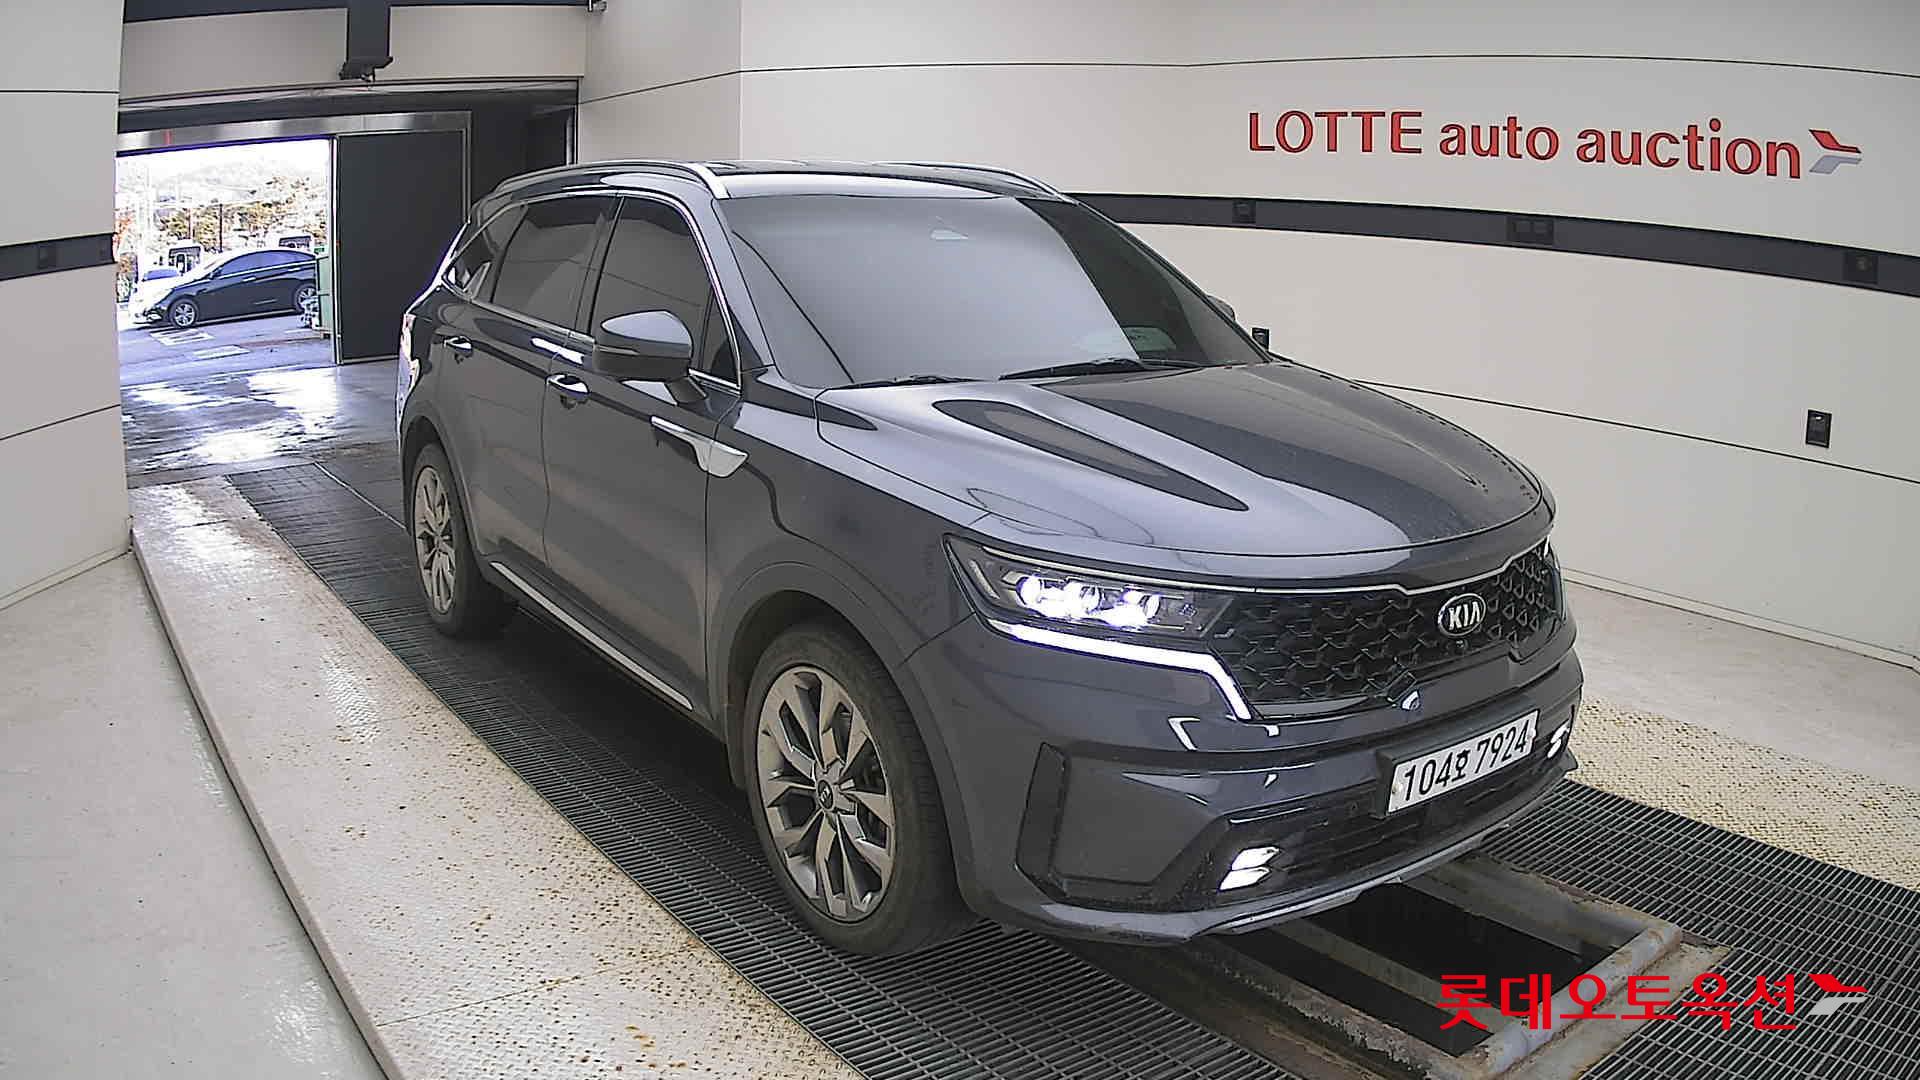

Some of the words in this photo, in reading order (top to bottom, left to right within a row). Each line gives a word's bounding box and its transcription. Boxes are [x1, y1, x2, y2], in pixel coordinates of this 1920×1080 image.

[1248, 110, 1423, 154] LOTTE
[1438, 115, 1560, 160] auto
[1576, 117, 1801, 179] auction
[1448, 601, 1482, 631] KIA
[1404, 749, 1471, 801] 104호
[1475, 719, 1530, 774] 7924
